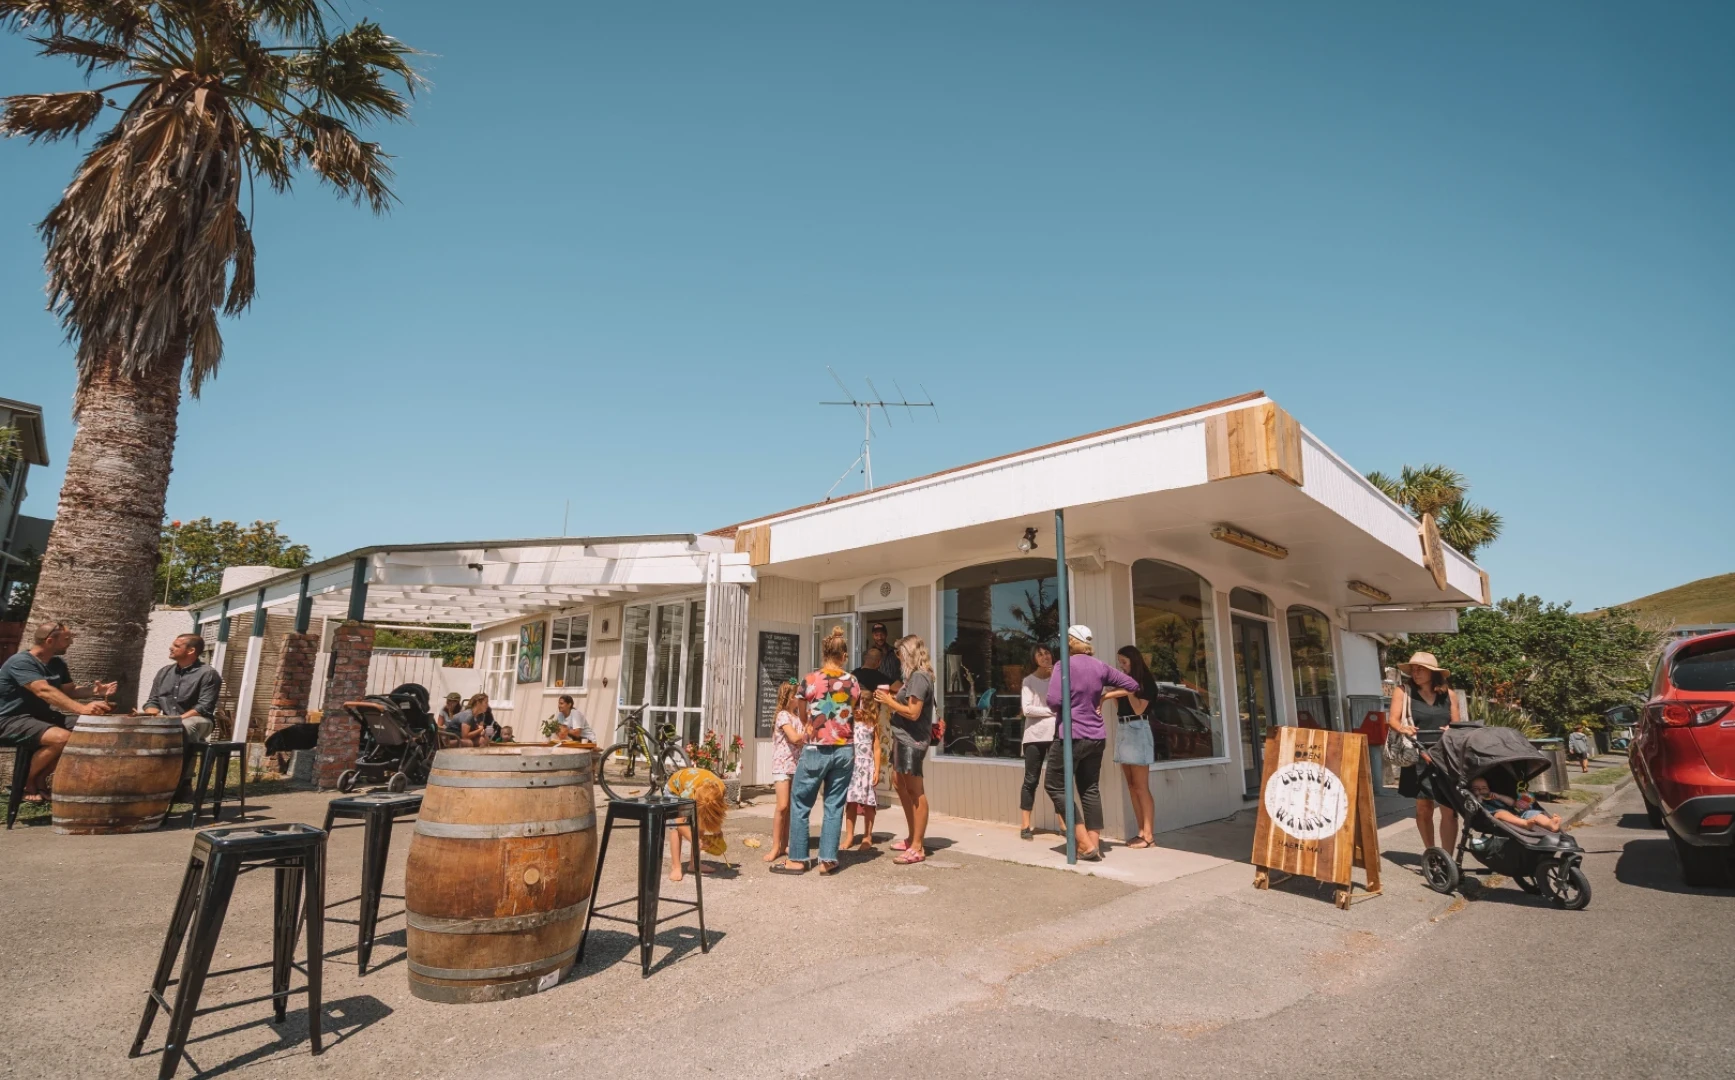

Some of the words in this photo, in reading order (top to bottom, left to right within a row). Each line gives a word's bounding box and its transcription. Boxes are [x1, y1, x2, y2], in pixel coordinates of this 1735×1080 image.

[1295, 751, 1321, 760] OPEN
[1276, 806, 1331, 830] WAINUI
[1278, 841, 1304, 850] HAERE
[1307, 846, 1323, 855] MAI
